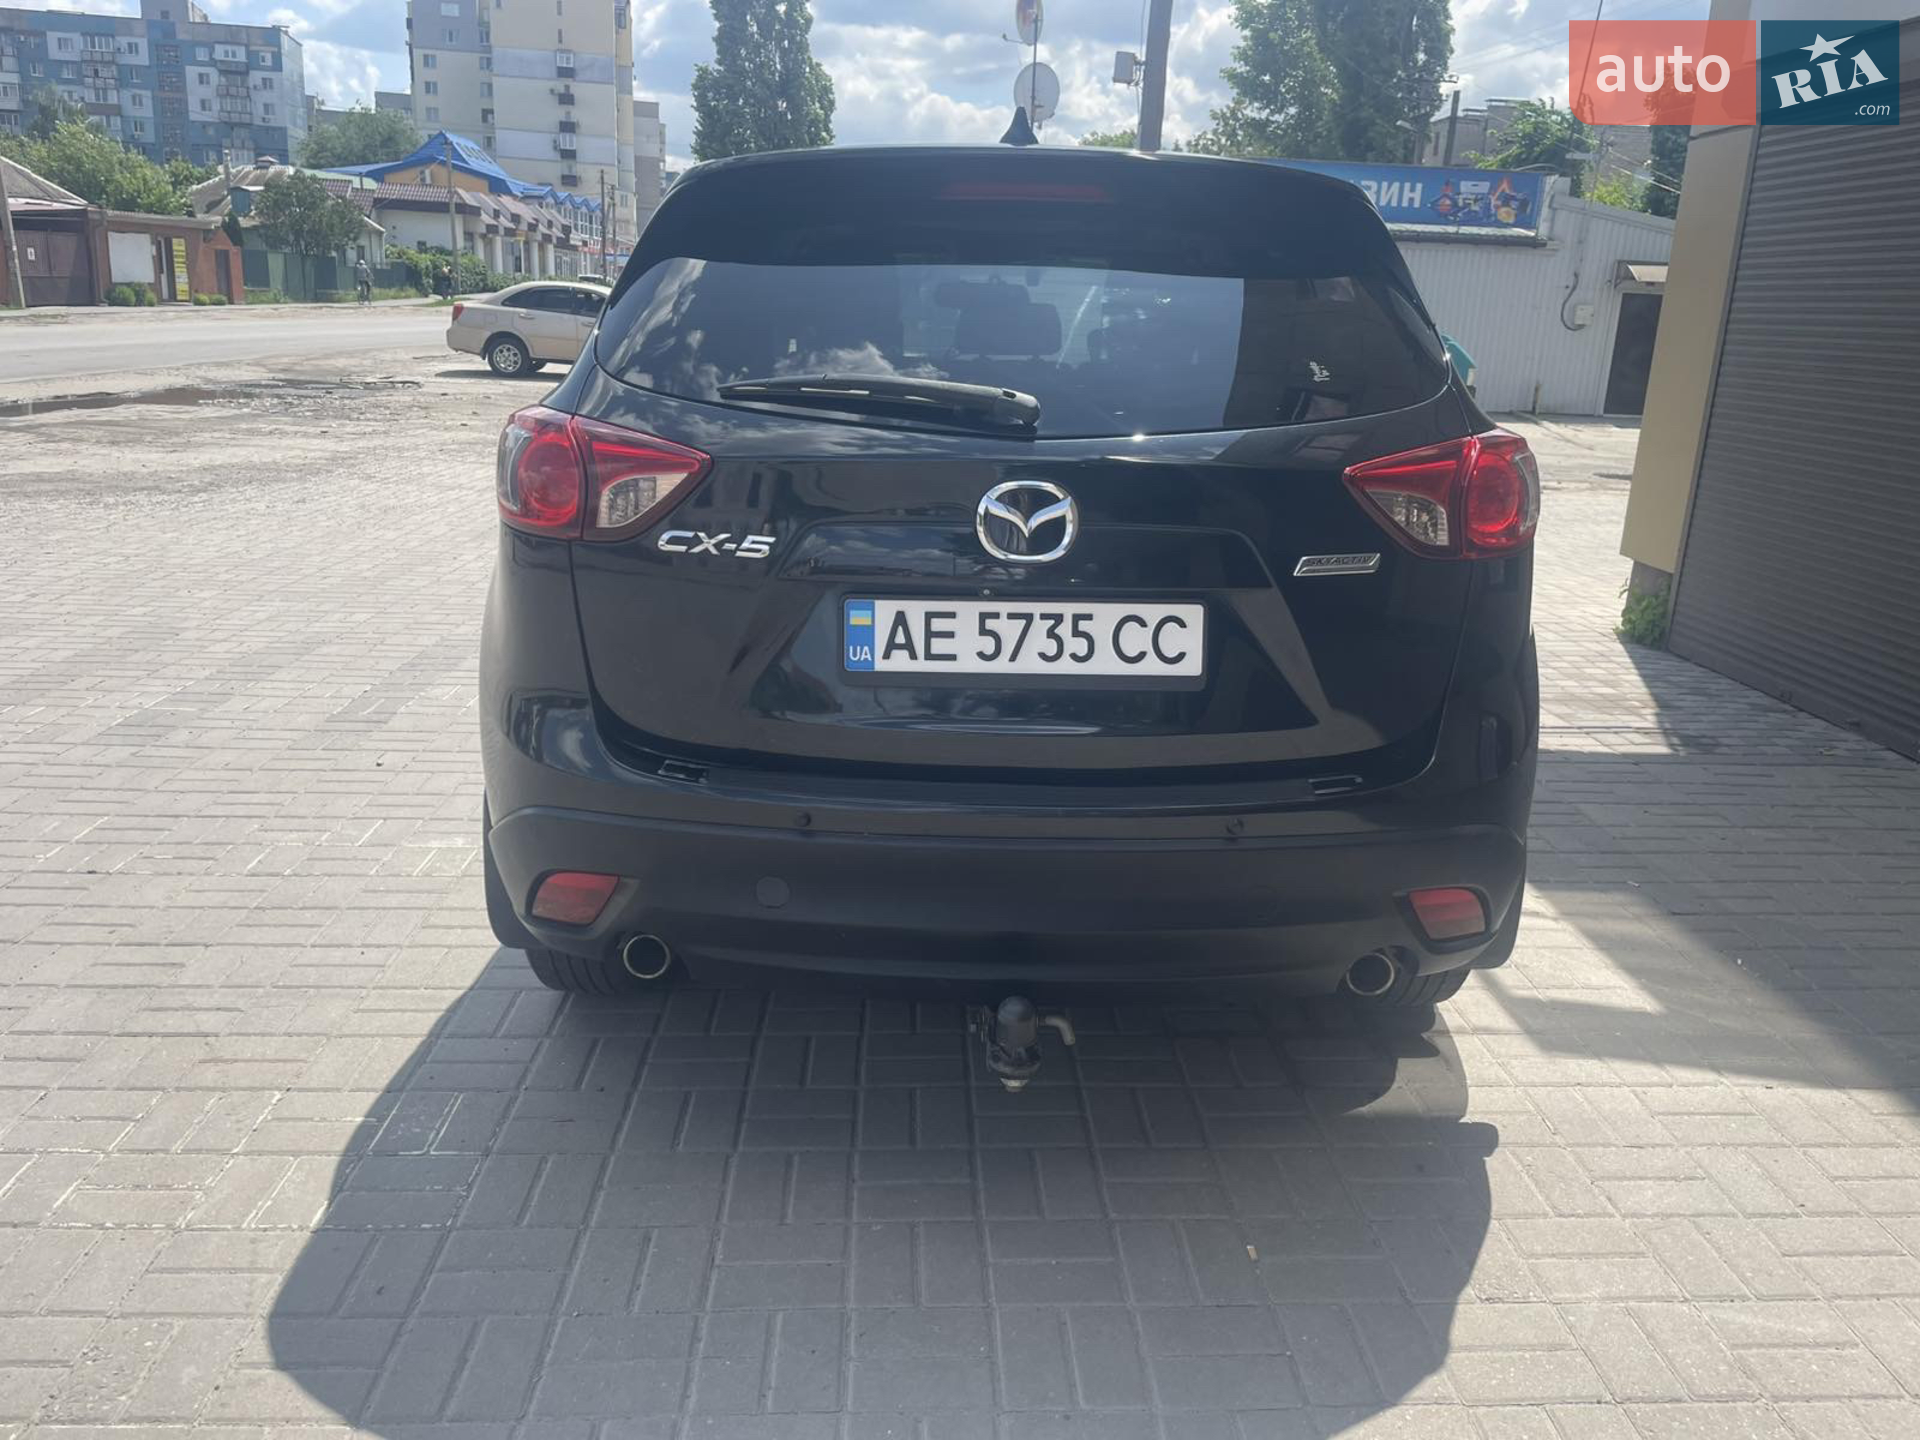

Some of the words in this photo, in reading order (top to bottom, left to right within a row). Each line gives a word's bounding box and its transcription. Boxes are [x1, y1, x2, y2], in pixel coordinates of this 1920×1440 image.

[1350, 180, 1423, 208] ЗИН
[657, 530, 777, 558] CX-5
[881, 611, 958, 661] AE
[976, 611, 1096, 664] 5735
[1111, 613, 1188, 665] CC
[850, 646, 872, 662] UA
